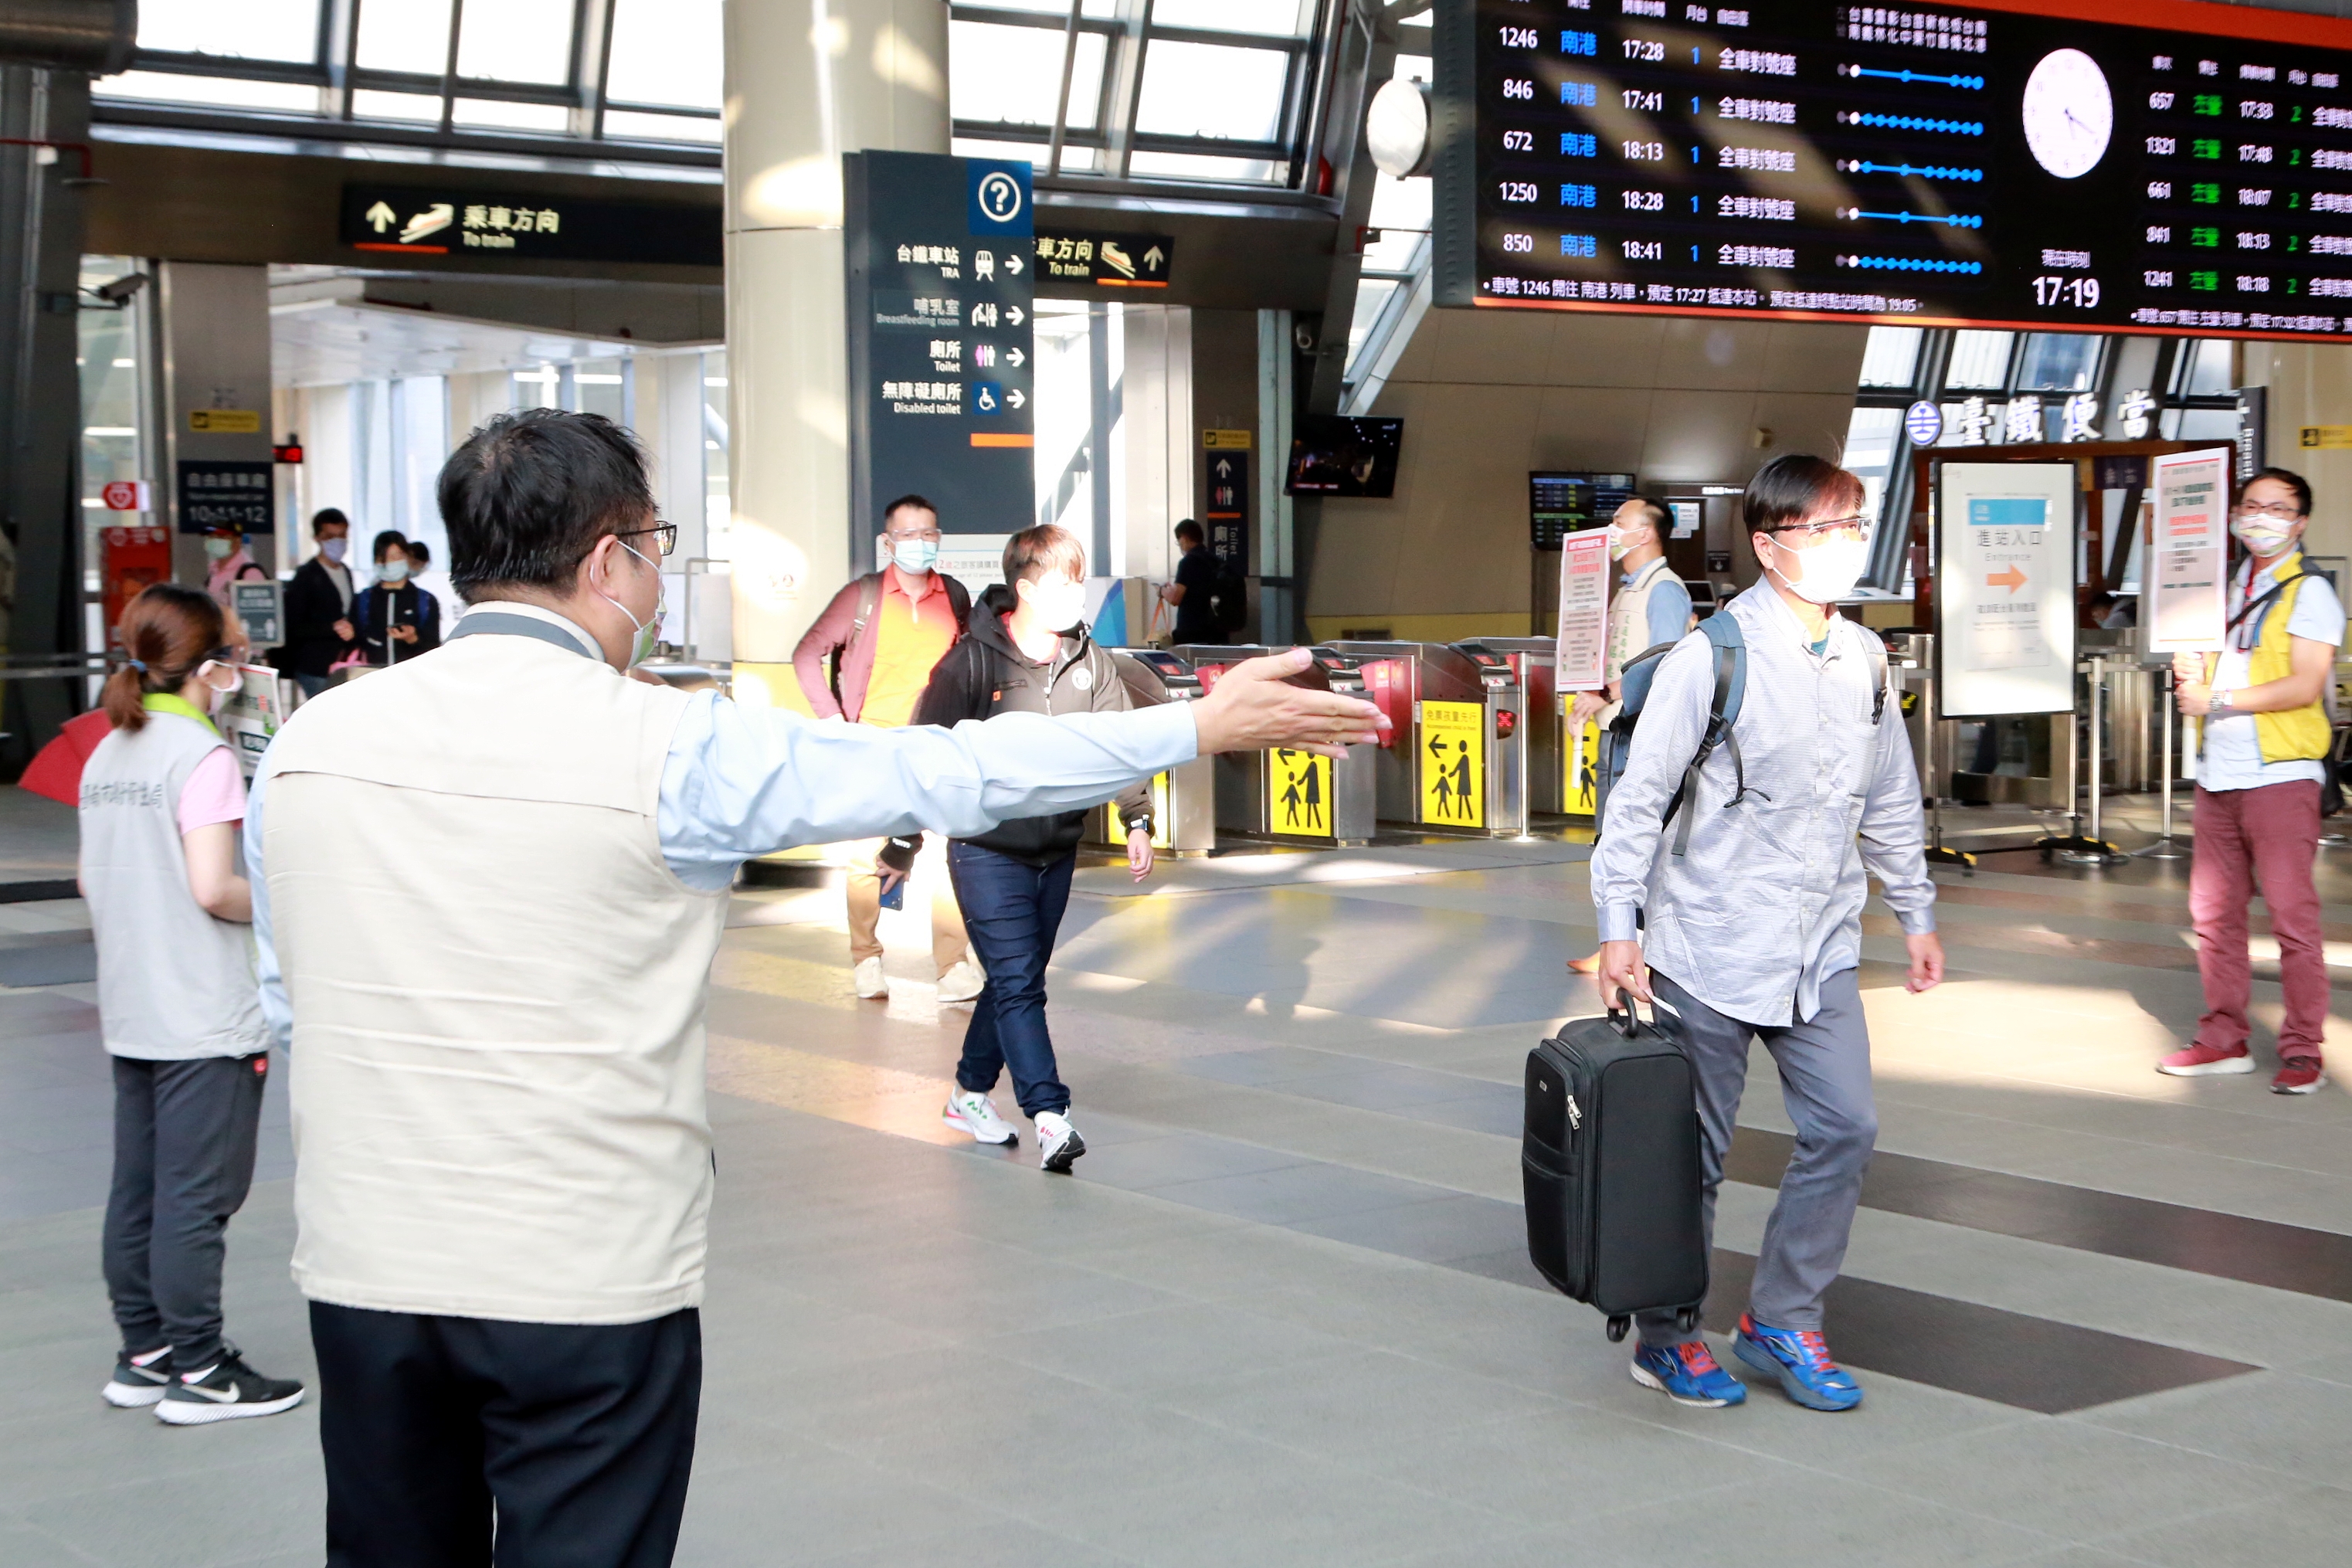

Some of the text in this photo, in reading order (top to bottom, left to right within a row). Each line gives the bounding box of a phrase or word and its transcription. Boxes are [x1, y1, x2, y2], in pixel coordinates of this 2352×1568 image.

[1685, 4, 1708, 22] 月台
[1498, 26, 1797, 76] 1246 南港 17:28 1 全車對號座
[1502, 78, 1797, 124] 846 南港 17:41 1 全車對號座
[2290, 106, 2302, 123] 2
[1503, 130, 1796, 172] 672 南港 18:13 1 全車對號座
[2289, 149, 2300, 165] 2
[1498, 182, 1796, 221] 1250 南港 18:28 1 全車對號座
[2288, 192, 2299, 209] 2
[463, 205, 559, 234] 乘車方向
[463, 232, 515, 248] To train
[1034, 237, 1093, 261] 車方向
[2287, 236, 2298, 252] 2
[897, 243, 959, 266] 台鐵車站
[1503, 233, 1795, 269] 850 南港 18:41 1 全車對號座
[940, 266, 960, 279] TRA
[1049, 261, 1090, 276] To train
[1491, 276, 1519, 295] 車號
[1521, 280, 1550, 296] 1246
[1552, 279, 1580, 298] 開往
[1580, 280, 1608, 299] 南港
[1675, 287, 1706, 303] 17:27
[2031, 276, 2100, 308] 17:19
[2287, 278, 2297, 294] 2
[913, 298, 959, 316] 哺乳室
[876, 313, 959, 328] Breastfeeding room
[929, 339, 962, 359] 廁所
[934, 360, 961, 373] Toilet
[882, 381, 962, 400] 無障礙廁所
[894, 401, 961, 415] Disabled toilet
[1229, 526, 1238, 555] Toilet
[1977, 529, 2042, 547] 進站入口
[1984, 553, 2031, 562] Entrance
